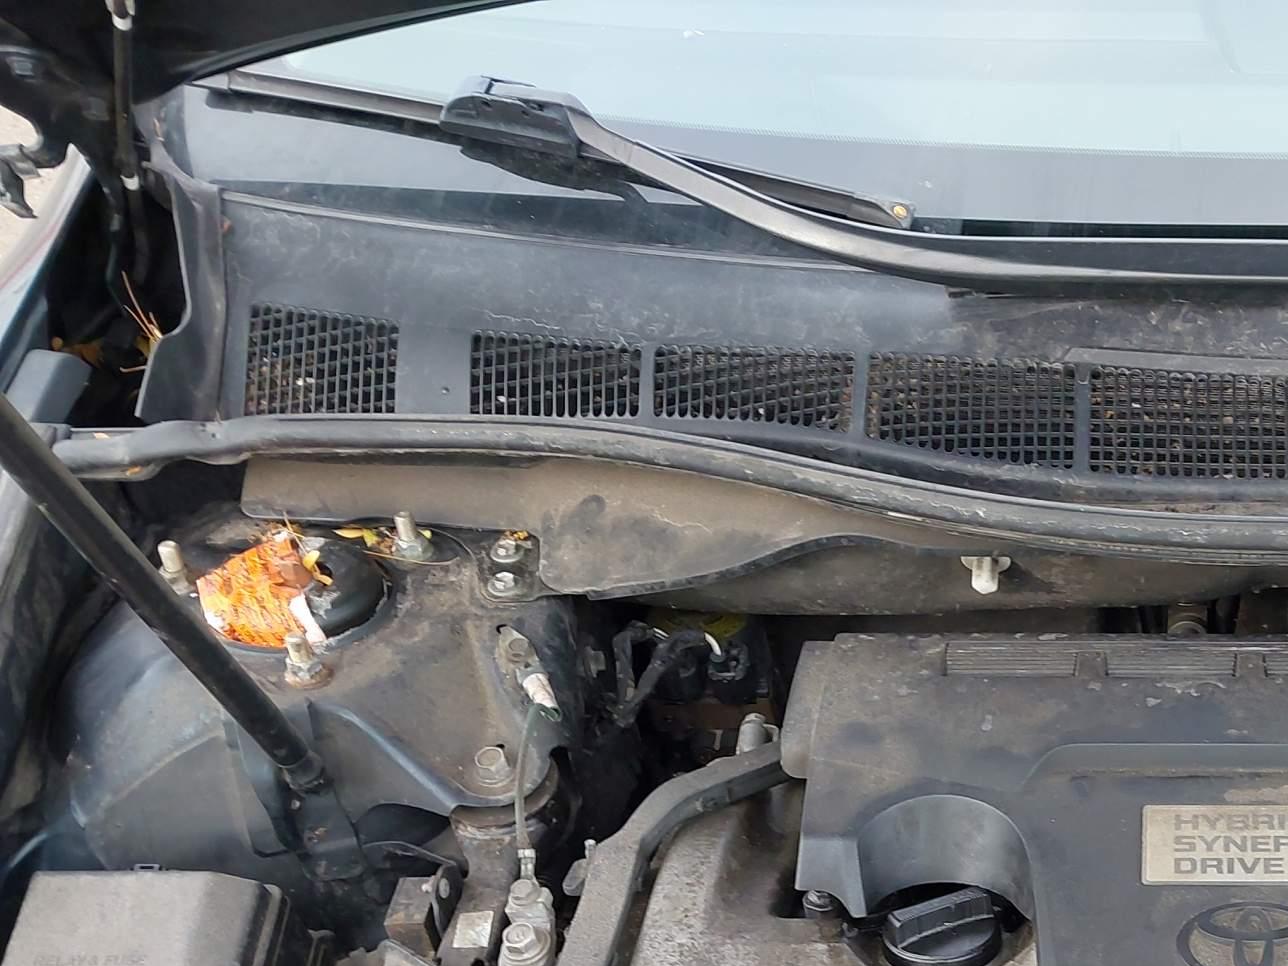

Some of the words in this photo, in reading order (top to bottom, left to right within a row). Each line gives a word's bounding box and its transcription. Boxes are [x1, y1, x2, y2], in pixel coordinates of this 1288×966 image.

[1174, 857, 1285, 874] DRIVE
[33, 953, 86, 966] RELAY
[103, 953, 147, 966] FUSE
